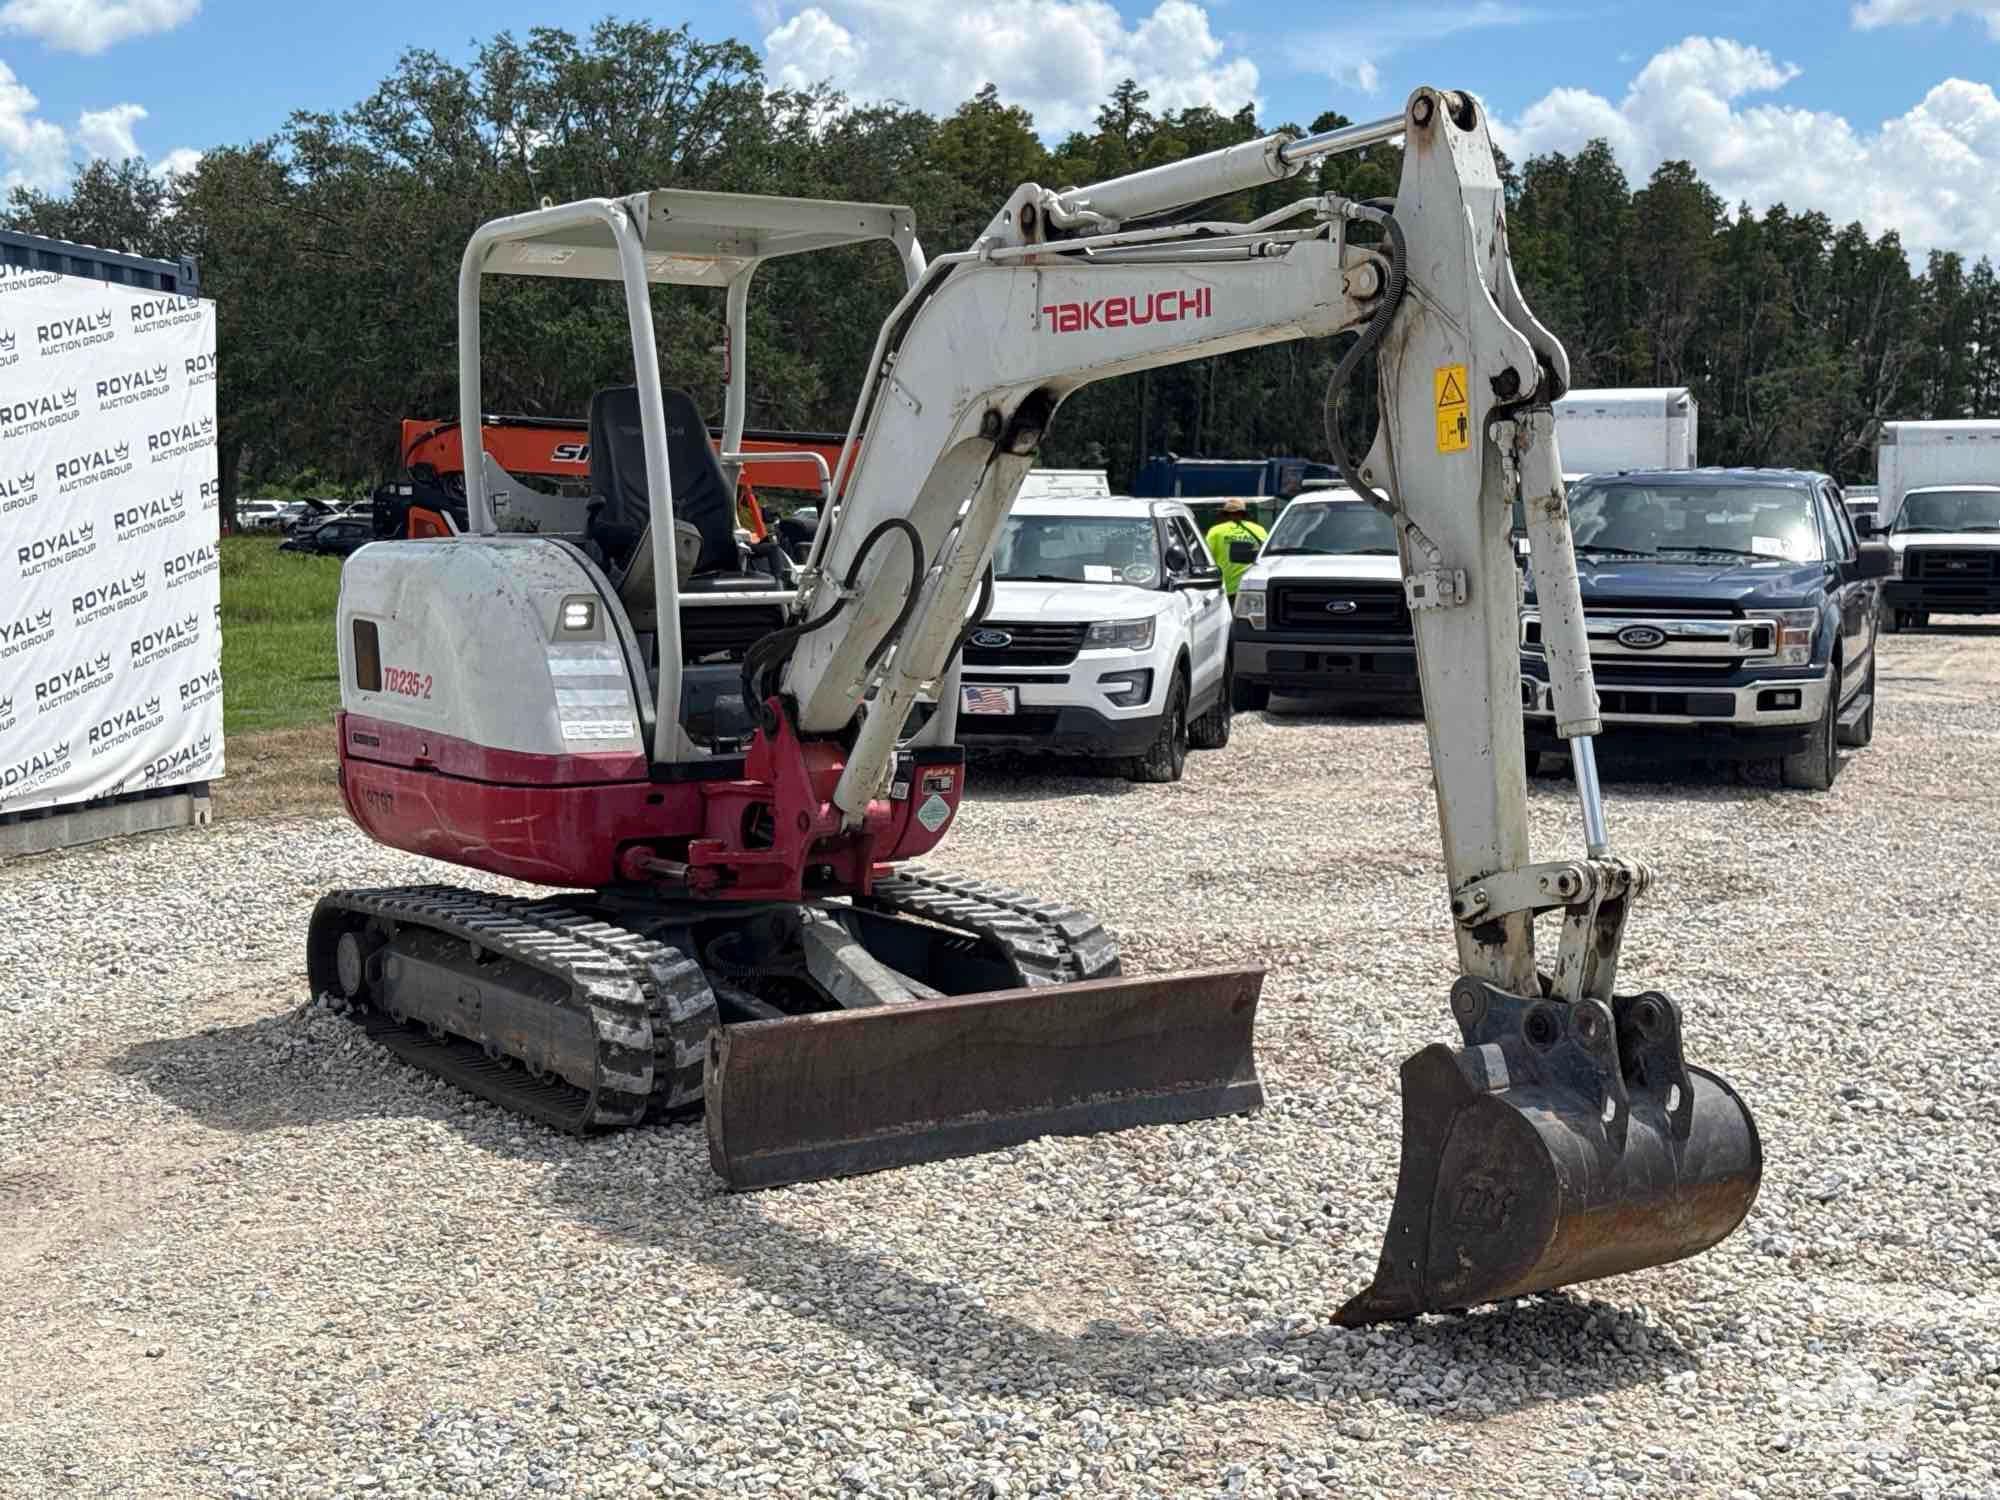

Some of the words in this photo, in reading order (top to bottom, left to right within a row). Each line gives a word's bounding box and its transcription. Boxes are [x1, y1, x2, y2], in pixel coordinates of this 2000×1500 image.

[0, 277, 27, 293] TION
[28, 273, 63, 288] GROUP
[131, 295, 186, 321] ROYAL
[134, 319, 172, 335] AUCTION
[172, 311, 202, 325] GROUP
[37, 315, 97, 344] ROYAL
[41, 339, 81, 356] AUCTION
[83, 331, 115, 347] GROUP
[185, 351, 217, 374] ROY
[188, 371, 217, 386] AUCTIO
[96, 369, 154, 398] ROYAL
[100, 391, 139, 412] AUCTION
[139, 384, 171, 400] GROUP
[0, 394, 63, 425] ROYAL
[3, 418, 47, 440] AUCTION
[48, 409, 80, 426] GROUP
[148, 422, 201, 450] ROYAL
[56, 449, 115, 480] ROYAL
[59, 473, 99, 495] AUCTION
[100, 462, 133, 480] GROUP
[3, 494, 38, 512] GROUP
[114, 497, 171, 529] ROYAL
[118, 520, 157, 542] AUCTION
[156, 510, 186, 528] GROUP
[18, 529, 80, 565] ROYAL
[21, 556, 64, 578] AUCTION
[65, 543, 97, 562] GROUP
[164, 545, 214, 577] ROYAL
[72, 578, 132, 614] ROYAL
[75, 603, 116, 627] AUCTION
[117, 590, 149, 610] GROUP
[0, 617, 37, 643] YAL
[21, 629, 55, 650] GROUP
[131, 622, 185, 658] ROYAL
[35, 661, 96, 701] ROYAL
[39, 688, 80, 714] AUCTION
[80, 672, 114, 694] GROUP
[179, 668, 220, 700] ROYA
[384, 667, 433, 699] TB235-2
[89, 705, 147, 744] ROYAL
[91, 731, 132, 757] AUCTION
[132, 714, 164, 737] GROUP
[0, 752, 54, 790] OYAL
[144, 744, 199, 781] ROYAL
